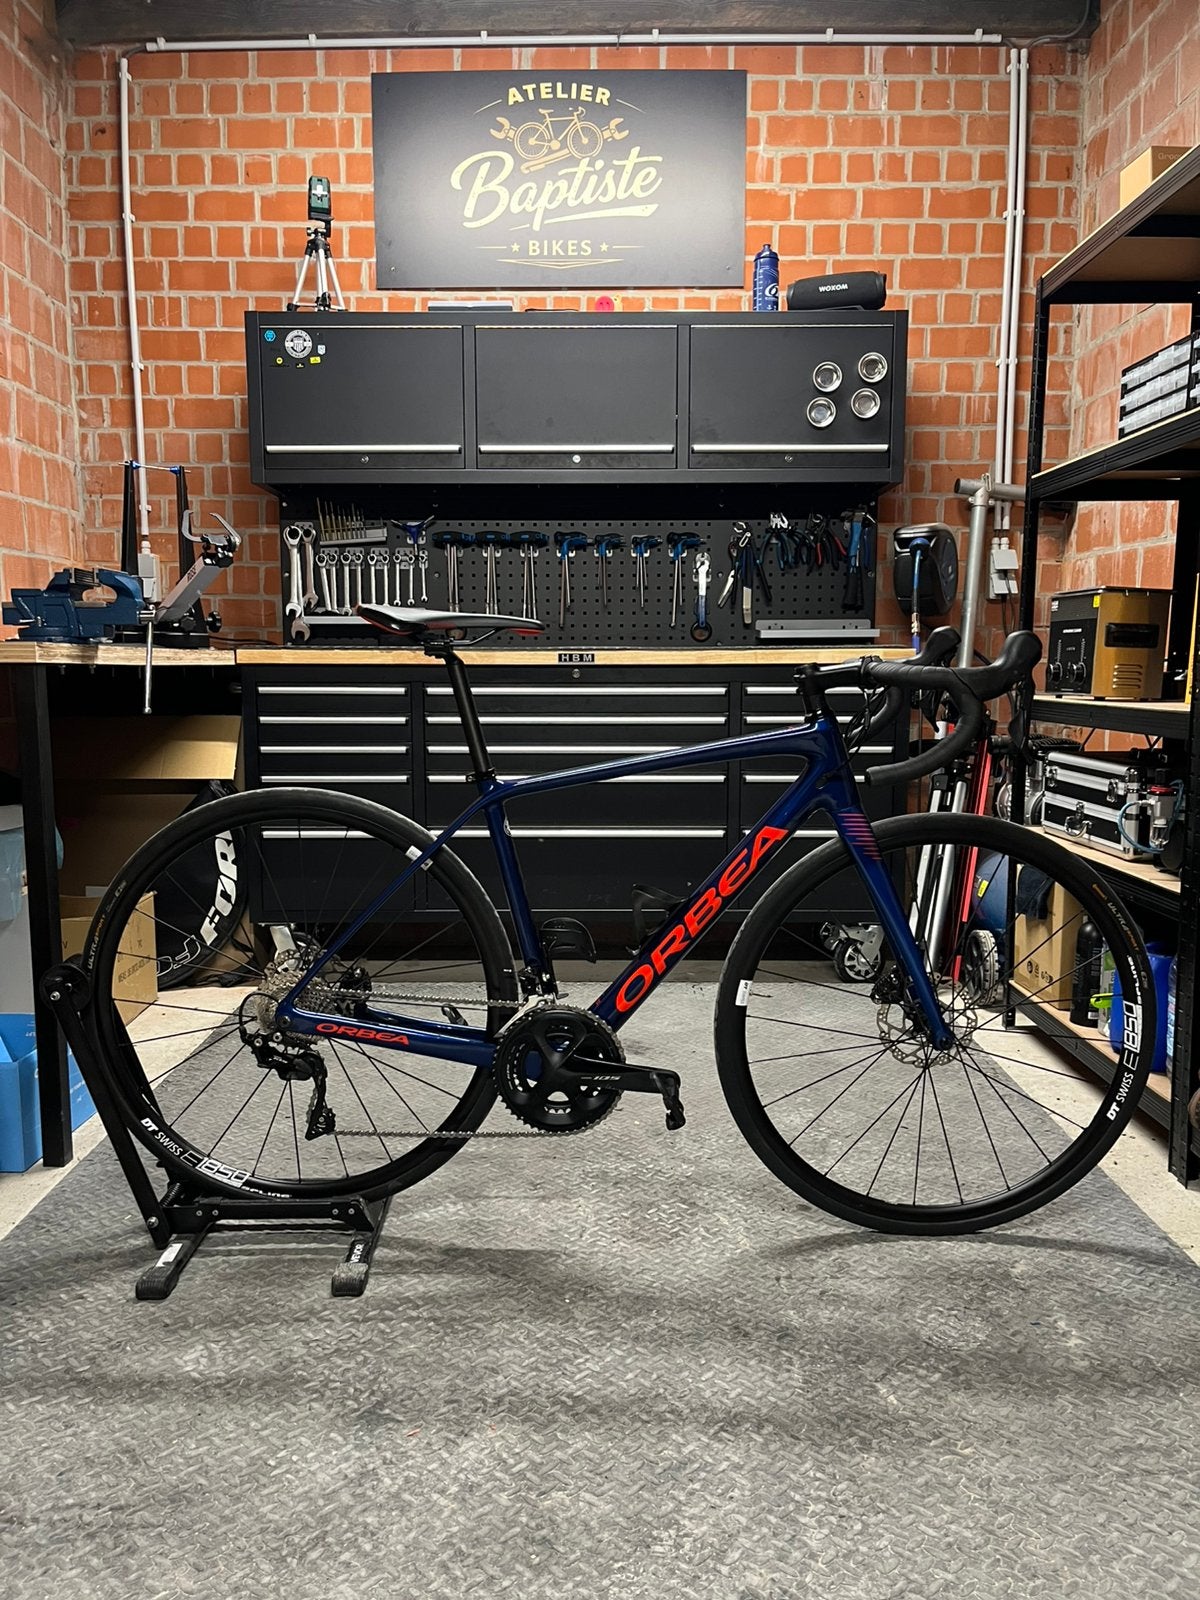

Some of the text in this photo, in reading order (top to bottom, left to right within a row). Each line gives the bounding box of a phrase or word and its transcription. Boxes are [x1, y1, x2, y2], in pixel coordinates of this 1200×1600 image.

[508, 82, 611, 106] ATELIER
[450, 146, 663, 231] Baptiste
[528, 239, 592, 256] BIKES
[818, 283, 849, 293] WOXOM
[561, 653, 593, 662] HBM
[615, 825, 789, 1013] ORBEA
[315, 1022, 410, 1046] ORBEA
[1106, 1101, 1121, 1121] DT
[1115, 1072, 1134, 1104] SWISS
[140, 1117, 159, 1132] DT
[154, 1131, 184, 1156] SWISS
